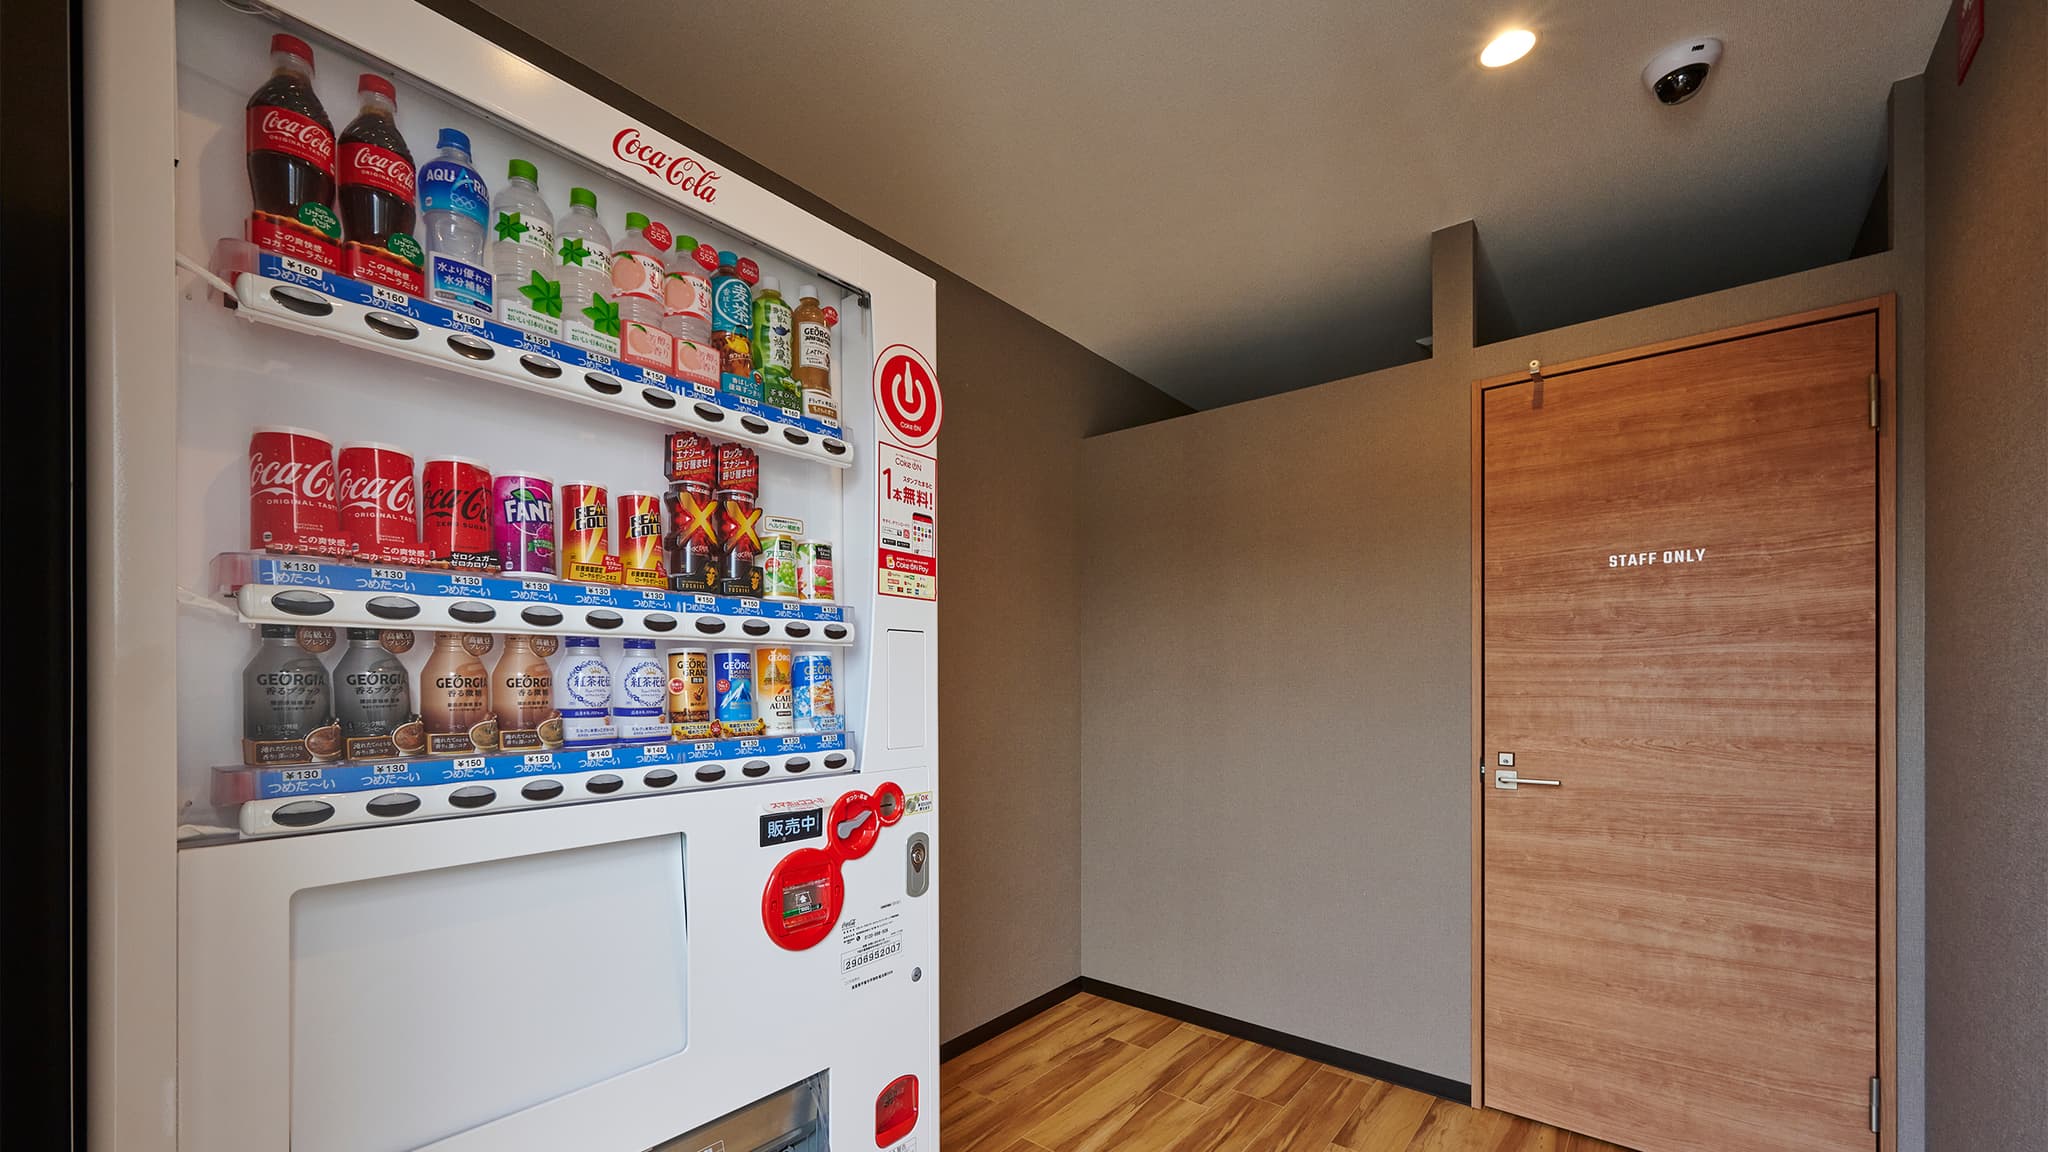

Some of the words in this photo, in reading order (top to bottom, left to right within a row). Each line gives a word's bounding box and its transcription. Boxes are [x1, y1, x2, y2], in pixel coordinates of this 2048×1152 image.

[262, 110, 332, 157] Coca-Cola
[269, 134, 306, 149] ORIGINAL
[354, 147, 414, 190] Coca-Cola
[612, 128, 722, 203] Coca-Cola
[361, 169, 395, 183] ORIGINAL
[304, 208, 336, 225] リサイクル
[287, 258, 318, 278] ¥160
[437, 262, 491, 287] 水より優れた
[443, 274, 486, 296] 水分補給
[376, 289, 405, 304] ¥160
[732, 283, 749, 323] 麦茶
[456, 312, 481, 327] ¥160
[525, 333, 549, 346] ¥130
[588, 352, 610, 364] ¥130
[645, 370, 664, 382] ¥150
[696, 384, 713, 396] ¥150
[895, 457, 911, 469] Coke
[911, 462, 922, 472] ON
[266, 498, 315, 507] ORIGINAL
[354, 512, 398, 520] ORIGINAL
[504, 499, 553, 523] FANT
[299, 535, 350, 548] この爽快感。
[274, 542, 352, 555] コカ・コーラだけ。
[382, 546, 428, 558] この爽快感。
[451, 552, 498, 563] ゼロシュガー
[1608, 551, 1657, 568] STAFF
[1663, 548, 1706, 564] ONLY
[283, 561, 317, 573] ¥130
[918, 565, 929, 575] Pay
[374, 569, 404, 580] ¥130
[454, 576, 481, 586] ¥130
[525, 582, 549, 592] ¥130
[588, 587, 609, 596] ¥130
[644, 591, 664, 600] ¥130
[256, 670, 325, 686] GEORGIA
[266, 686, 321, 696] 香るブラック
[589, 750, 610, 759] ¥140
[646, 746, 665, 754] ¥140
[457, 759, 482, 768] ¥150
[527, 754, 550, 764] ¥150
[376, 764, 406, 773] ¥130
[285, 770, 319, 780] ¥130
[767, 815, 815, 839] 販売中
[845, 942, 901, 971] 2906952007
